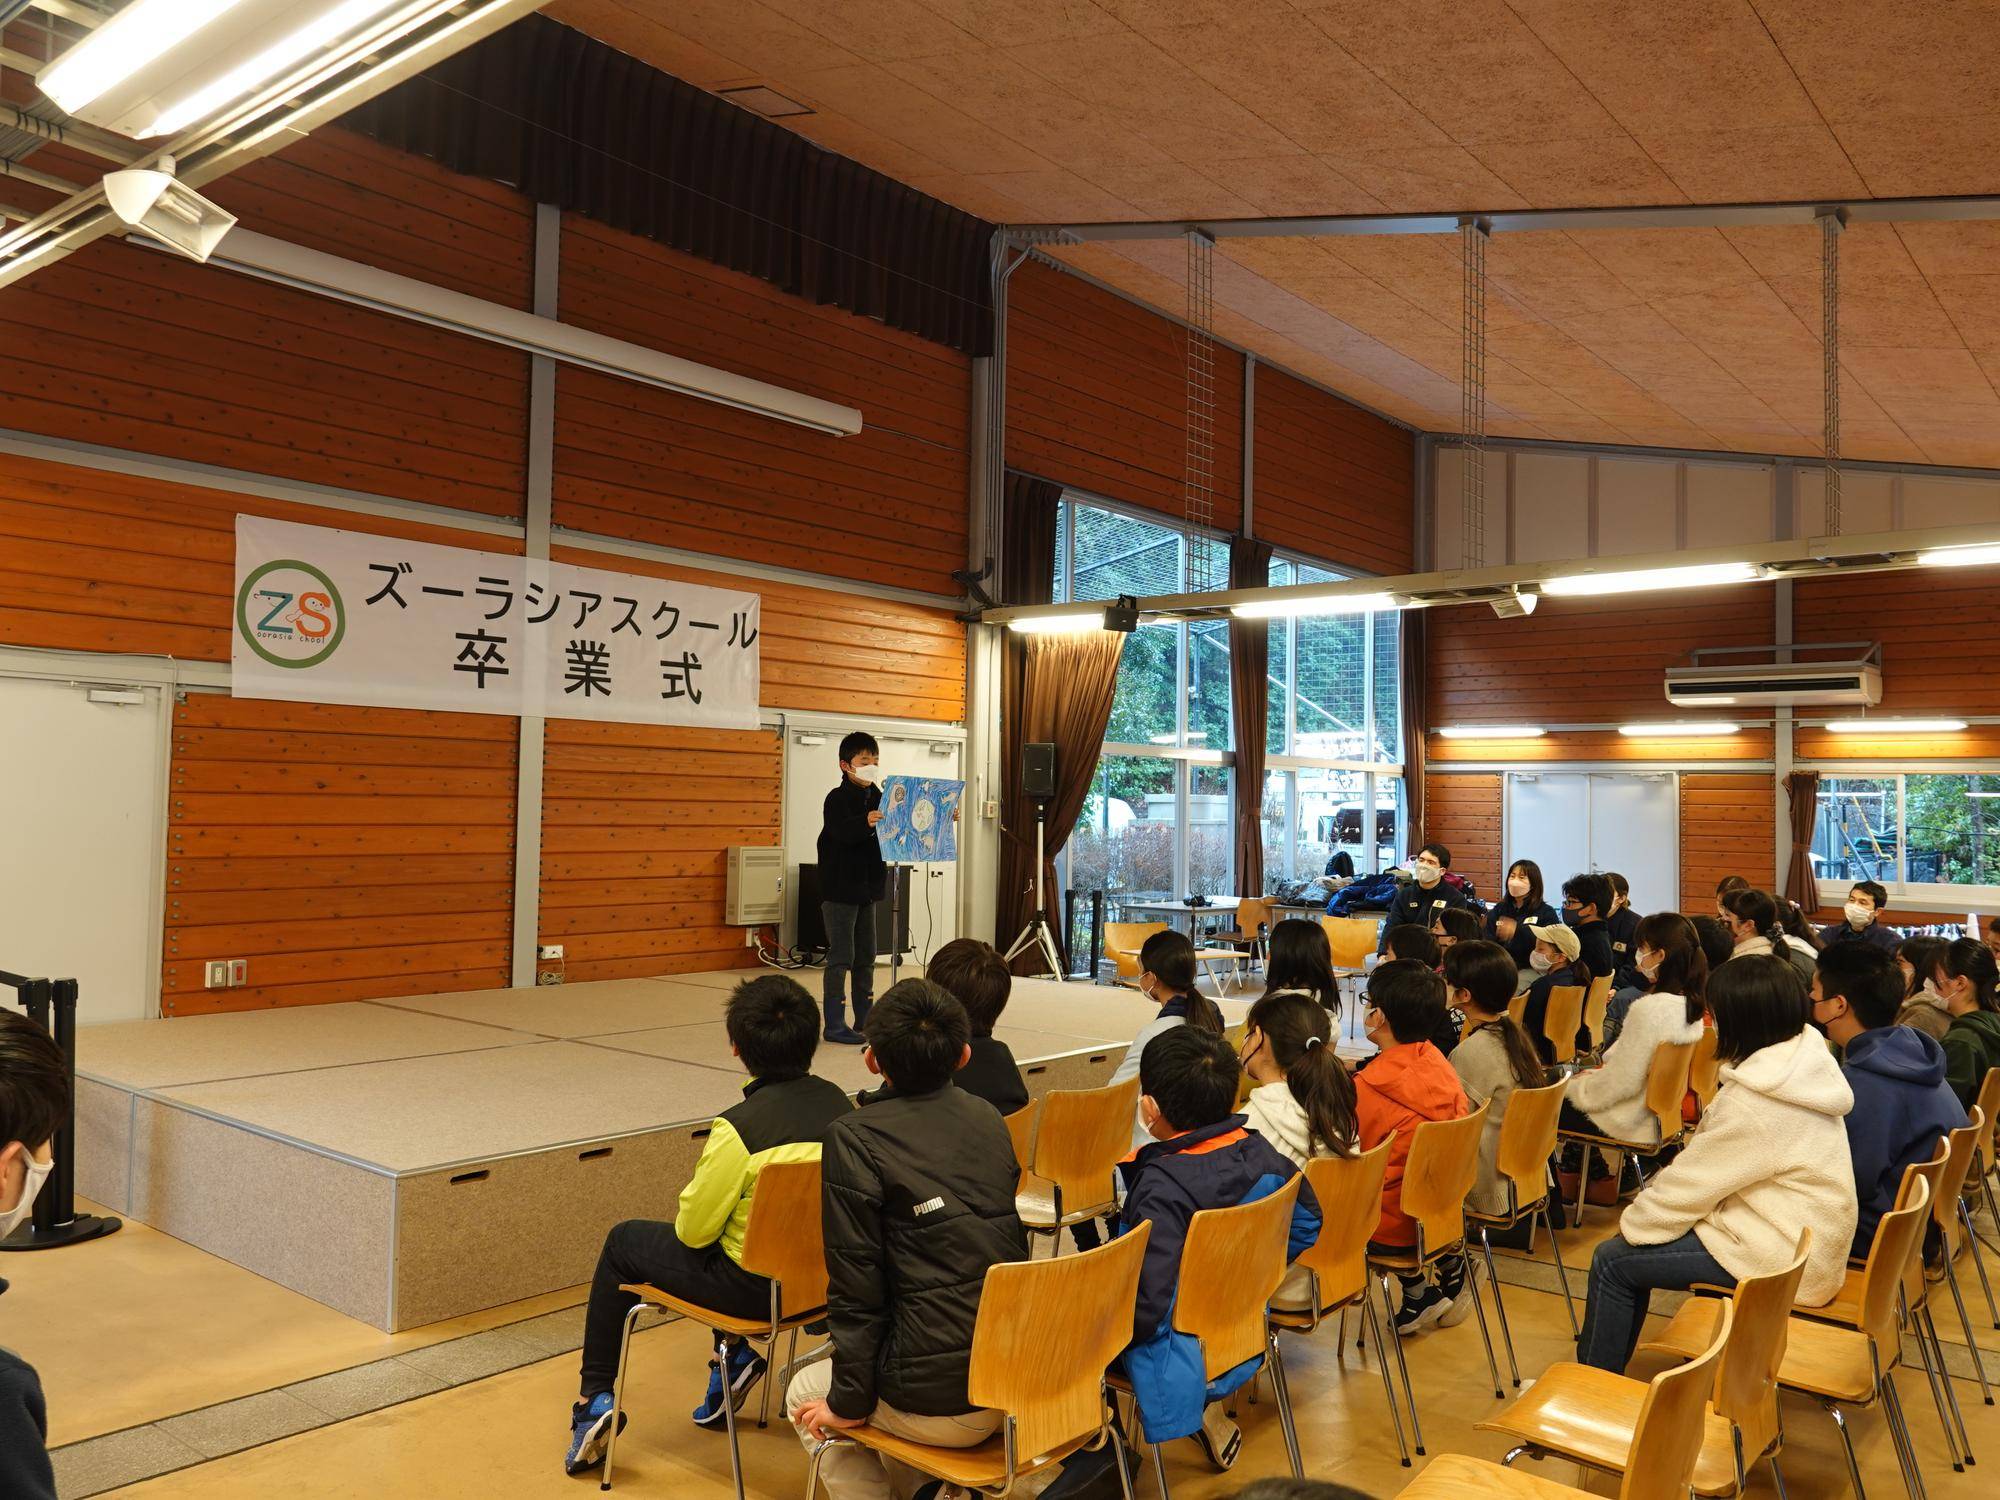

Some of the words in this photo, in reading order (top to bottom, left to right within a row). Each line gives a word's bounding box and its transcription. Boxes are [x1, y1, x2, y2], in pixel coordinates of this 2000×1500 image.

[365, 562, 757, 648] ズーラシアスクール
[453, 628, 702, 704] 卒業式
[913, 1196, 945, 1216] PUMA
